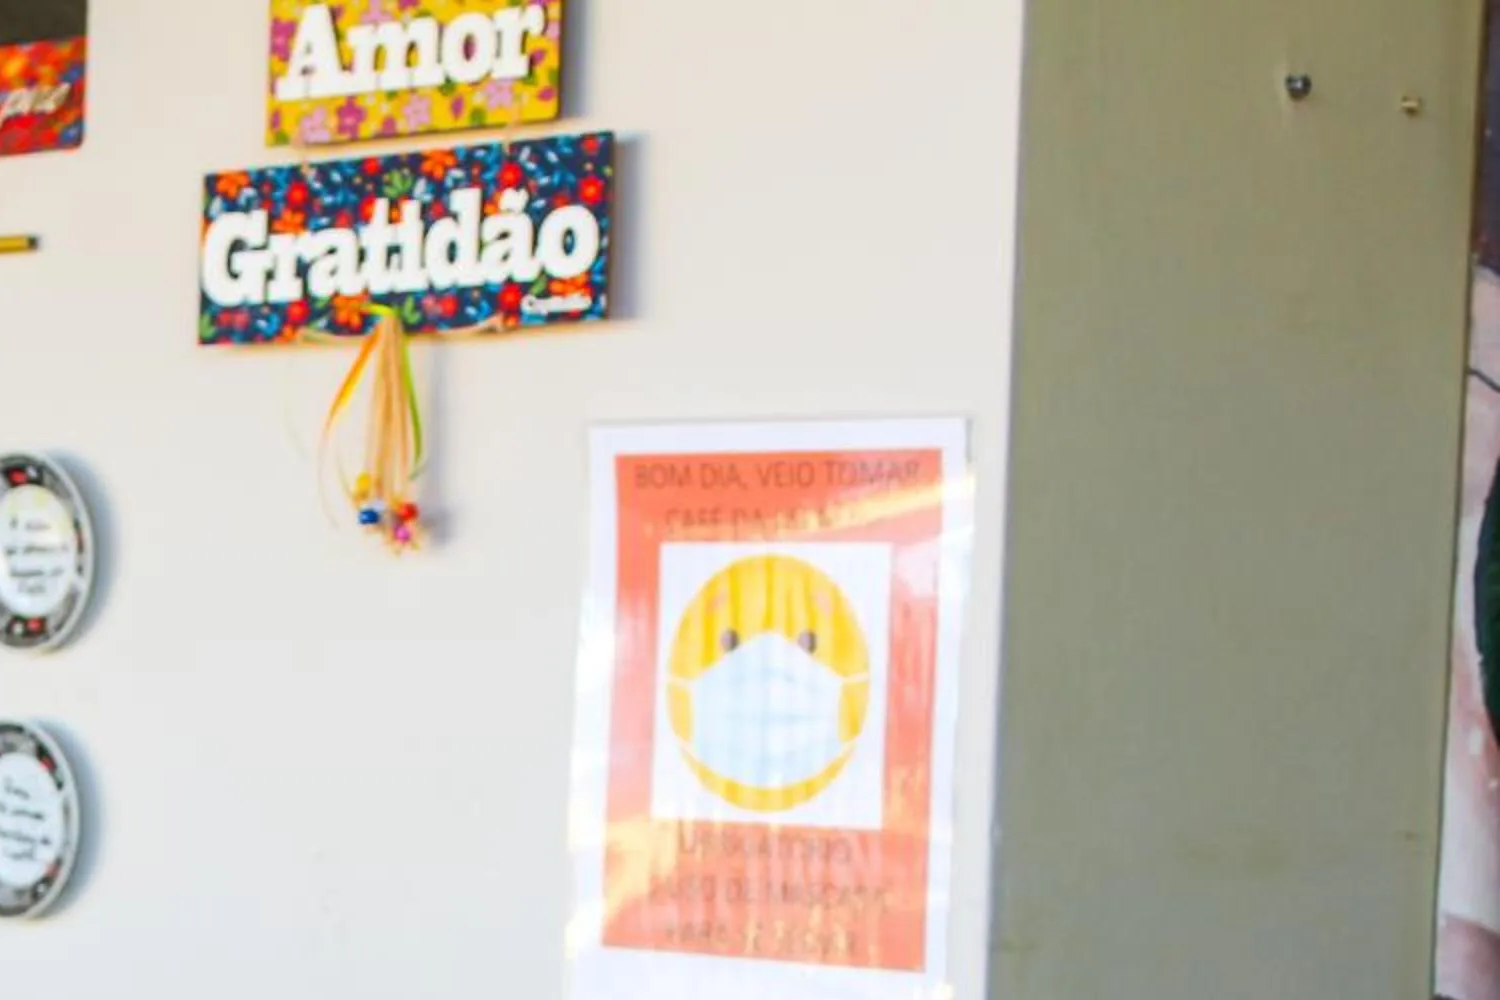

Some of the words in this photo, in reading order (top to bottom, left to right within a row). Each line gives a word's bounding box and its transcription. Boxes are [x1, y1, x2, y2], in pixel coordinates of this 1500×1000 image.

[275, 3, 546, 101] Amor
[200, 187, 599, 306] Gratidão
[634, 461, 692, 489] BOM
[755, 460, 816, 489] VEIO
